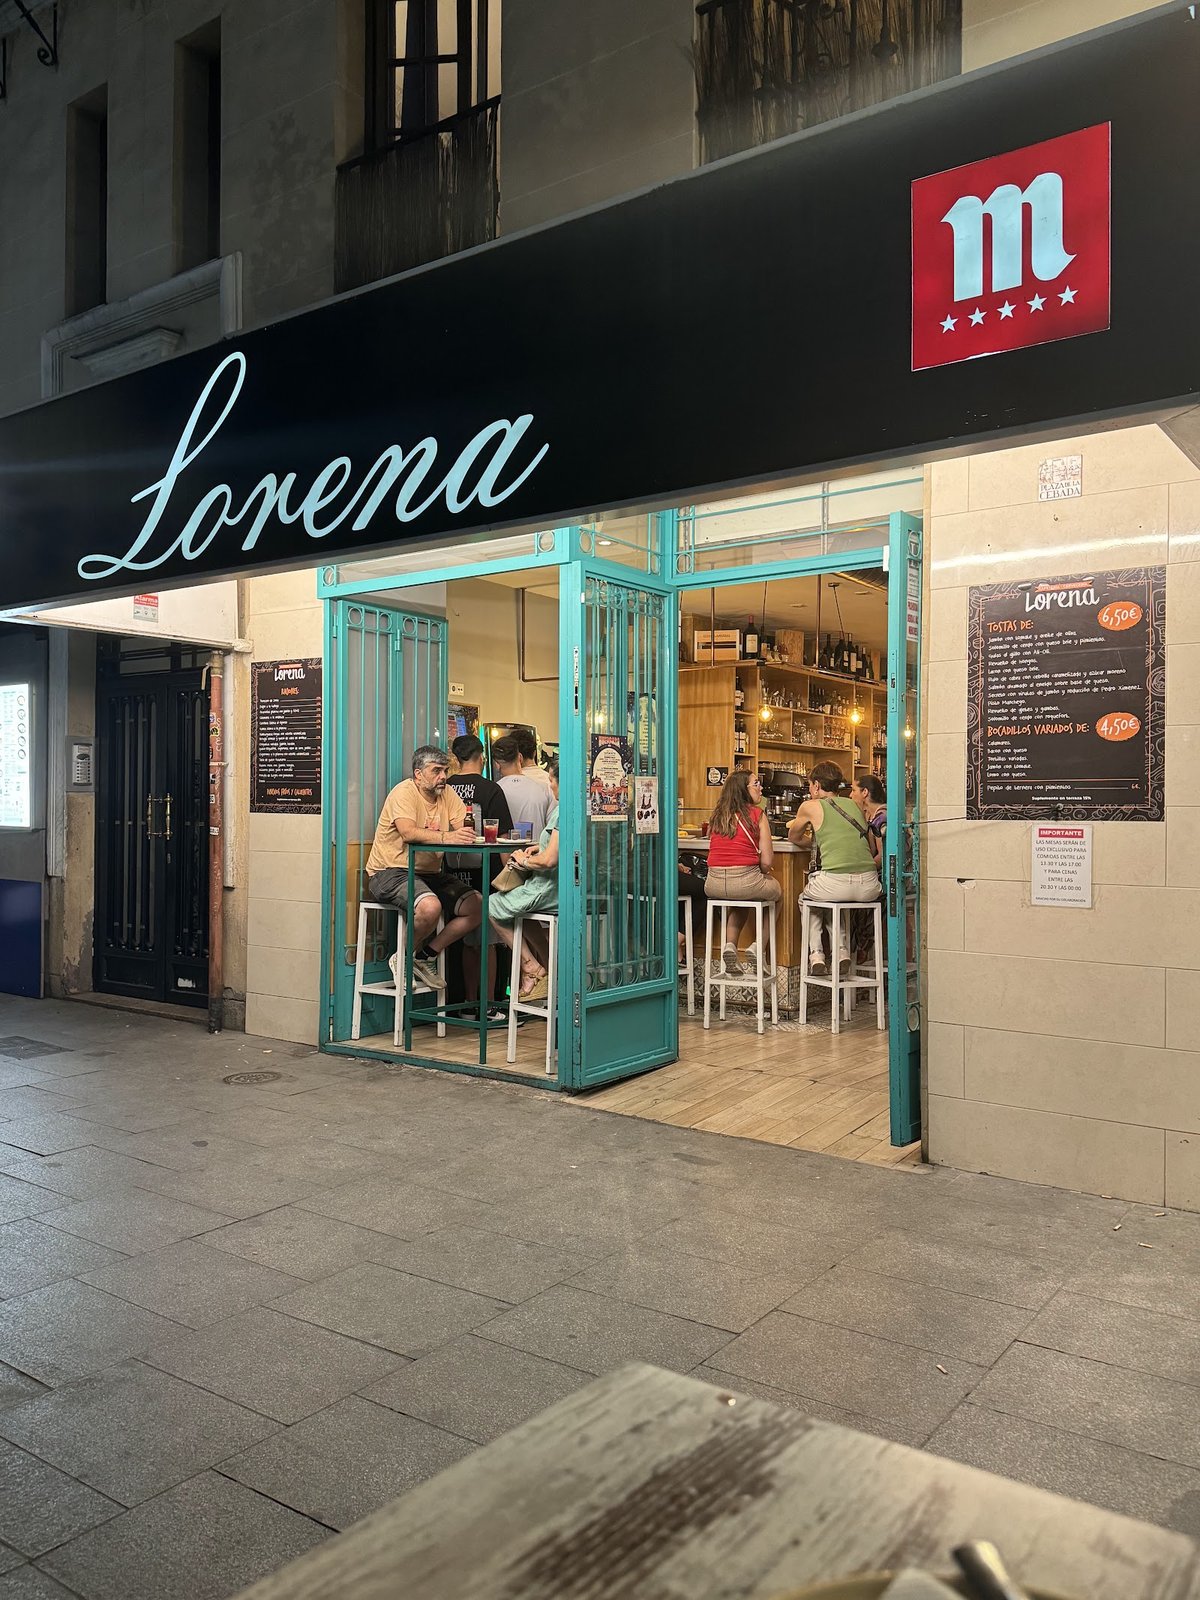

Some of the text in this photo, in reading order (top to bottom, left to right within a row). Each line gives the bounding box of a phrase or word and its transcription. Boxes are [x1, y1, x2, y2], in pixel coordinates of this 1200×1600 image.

[77, 351, 549, 580] Lorena
[1039, 487, 1080, 500] CEBADA
[1040, 482, 1065, 491] PLAZA
[1025, 587, 1100, 613] Lorena
[1102, 607, 1139, 627] 6,50€
[987, 619, 1034, 633] TOSTAS DE:
[274, 668, 306, 681] Lorena
[987, 722, 1090, 738] BOCADILLOS VARIADOS DE:
[1100, 717, 1140, 737] 4,50€
